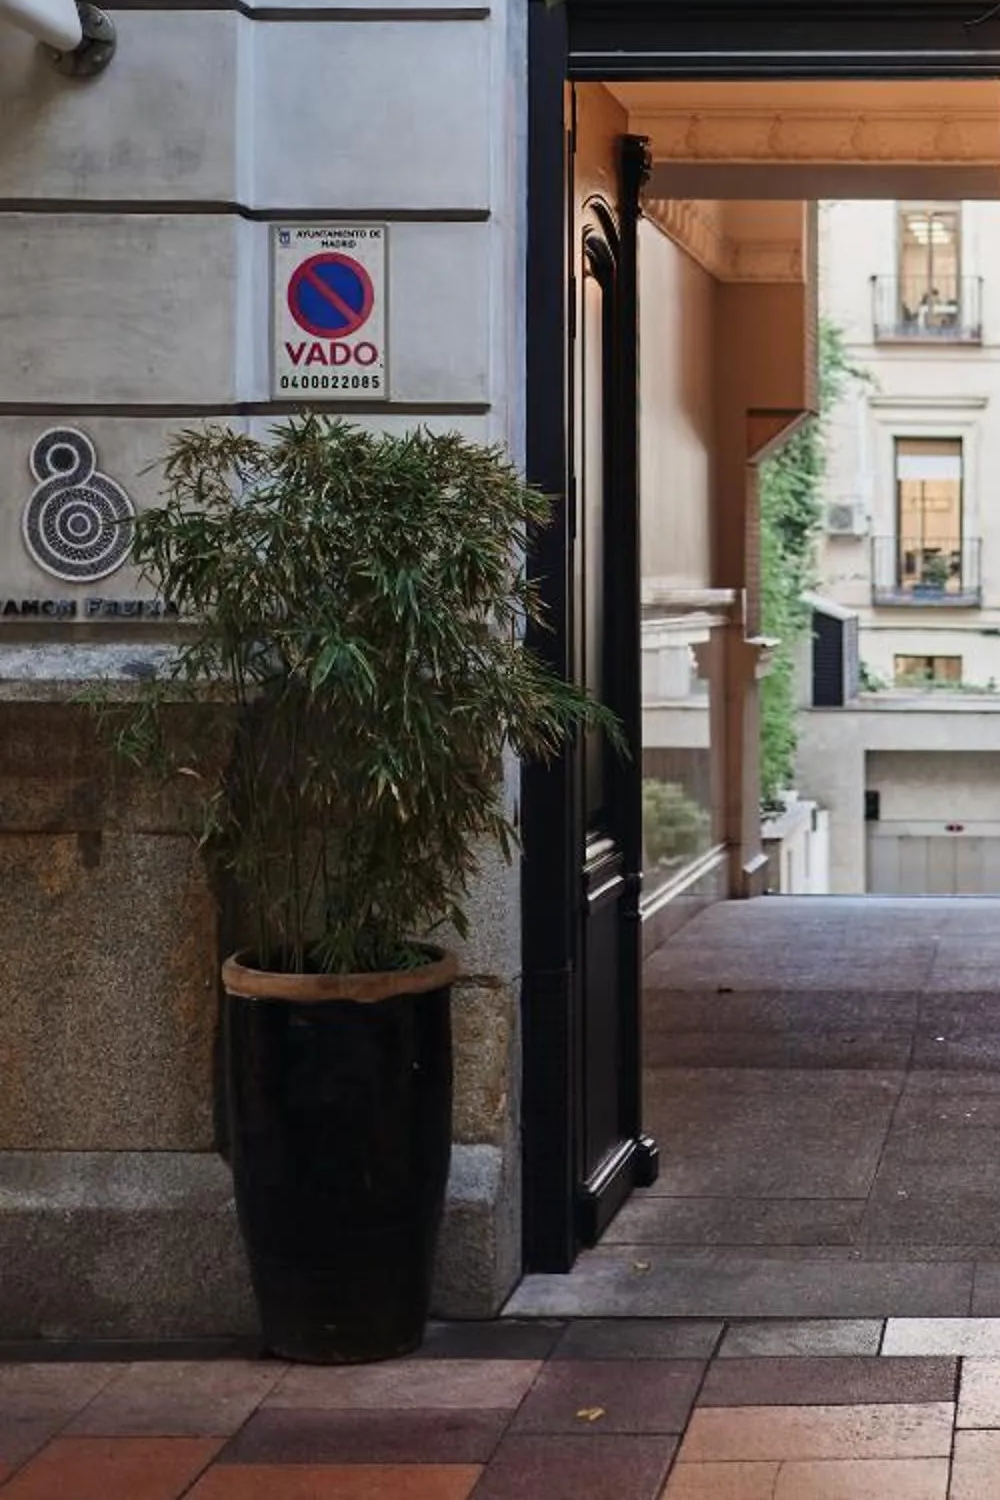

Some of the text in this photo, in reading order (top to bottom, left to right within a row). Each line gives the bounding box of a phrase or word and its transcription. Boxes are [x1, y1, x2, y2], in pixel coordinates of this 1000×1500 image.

[296, 229, 381, 239] AYUNTAMIENTO DE
[321, 239, 357, 249] MADRID
[284, 341, 378, 367] VADO
[280, 375, 380, 389] 0400022085
[0, 599, 78, 616] AMON
